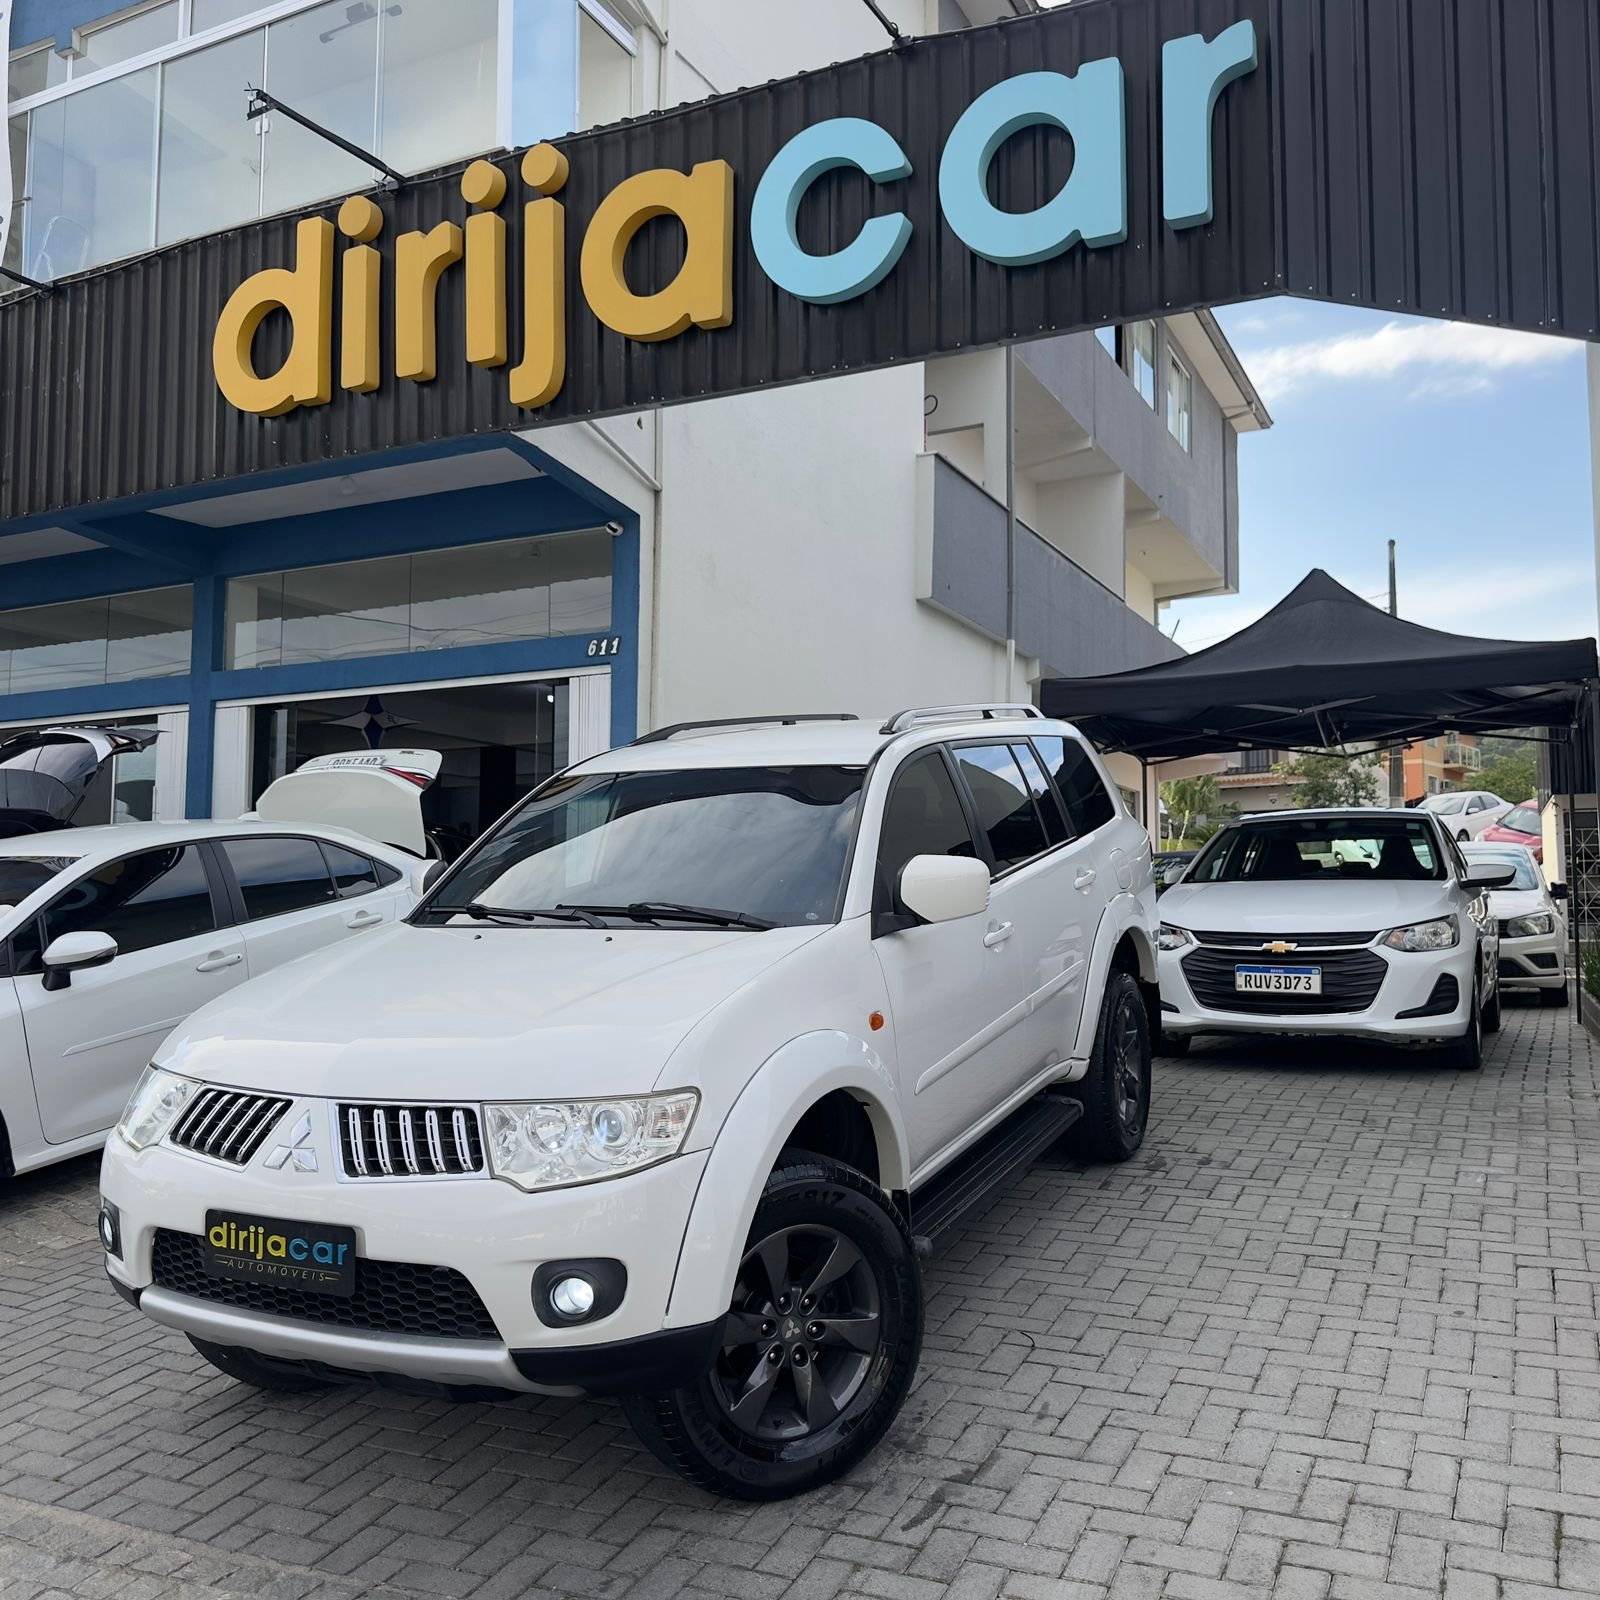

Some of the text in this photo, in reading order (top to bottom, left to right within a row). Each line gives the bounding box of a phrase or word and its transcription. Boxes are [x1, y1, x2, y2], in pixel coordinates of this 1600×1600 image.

[213, 19, 1258, 417] dirijacar
[588, 637, 619, 656] 611
[1244, 974, 1312, 990] RUV3D73
[208, 1221, 348, 1265] dirijacar
[227, 1259, 326, 1282] AUTOMÓVEIS
